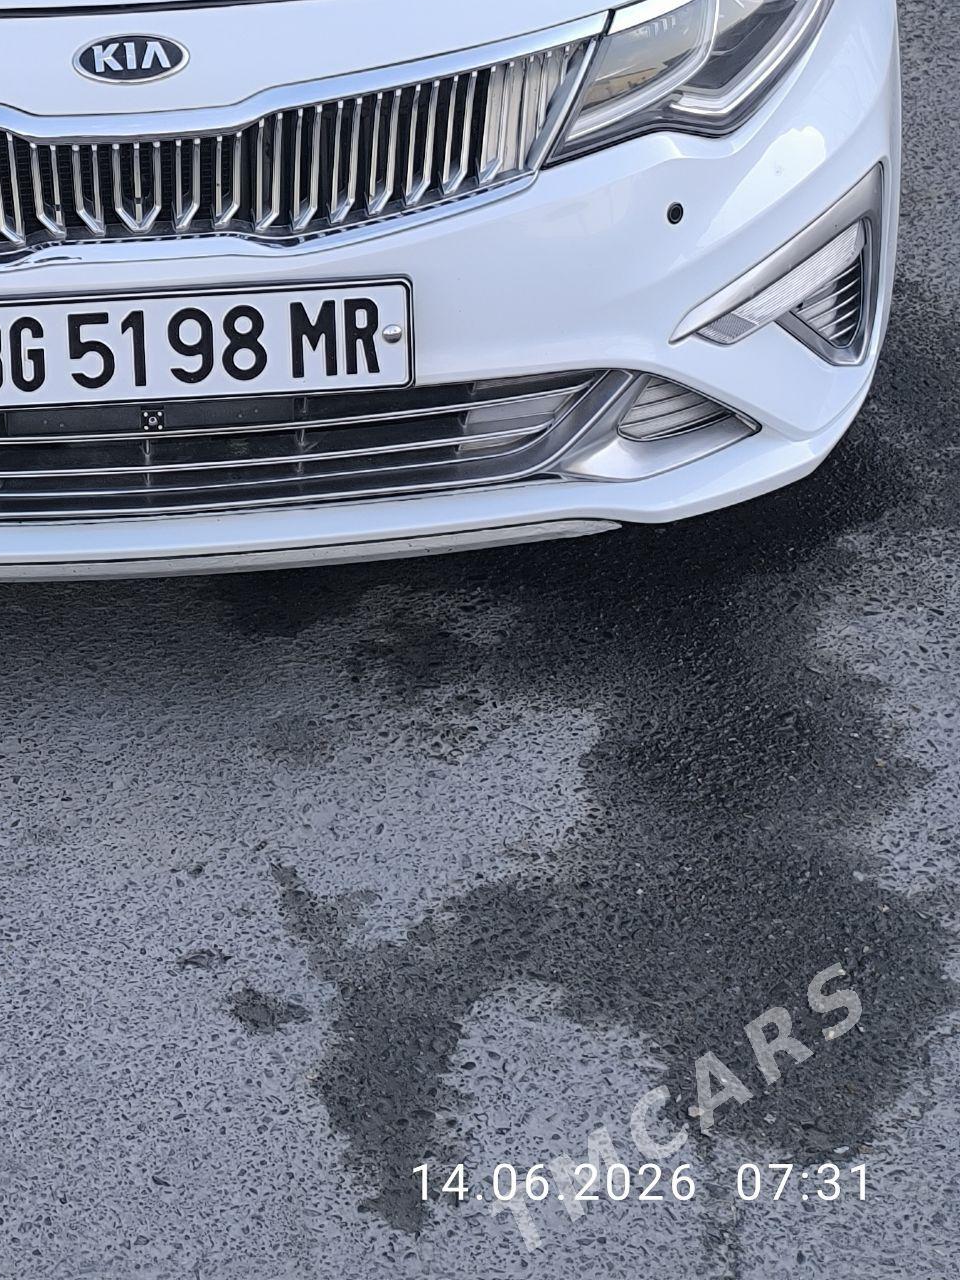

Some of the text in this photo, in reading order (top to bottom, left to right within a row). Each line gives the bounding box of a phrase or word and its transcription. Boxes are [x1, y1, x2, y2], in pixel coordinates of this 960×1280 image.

[91, 41, 172, 73] KIA
[68, 304, 269, 390] 5198
[289, 297, 381, 379] MR
